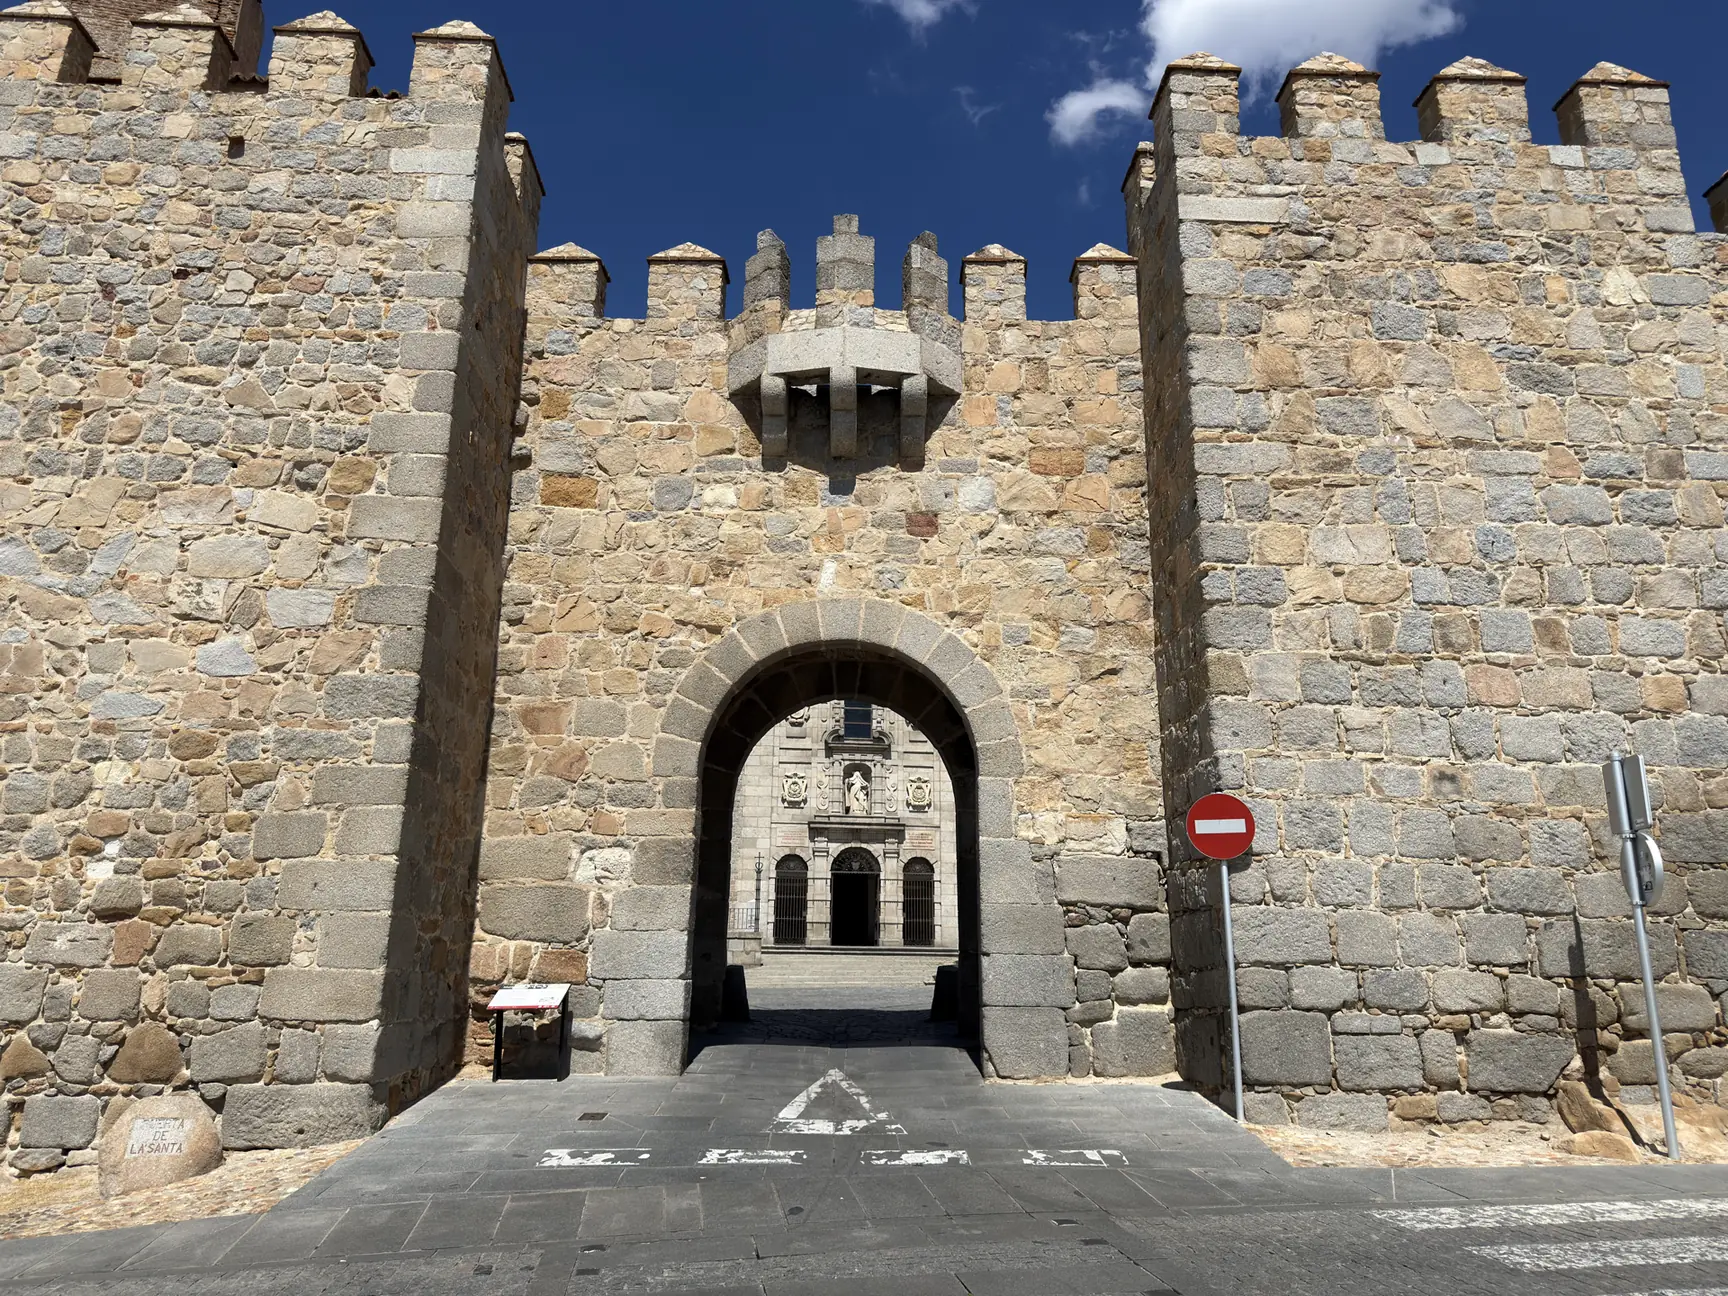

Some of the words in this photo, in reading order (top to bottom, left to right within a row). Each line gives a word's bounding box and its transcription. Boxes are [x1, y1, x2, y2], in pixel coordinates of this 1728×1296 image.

[152, 1131, 169, 1141] DE
[130, 1143, 145, 1155] LA
[147, 1143, 183, 1154] SANTA
